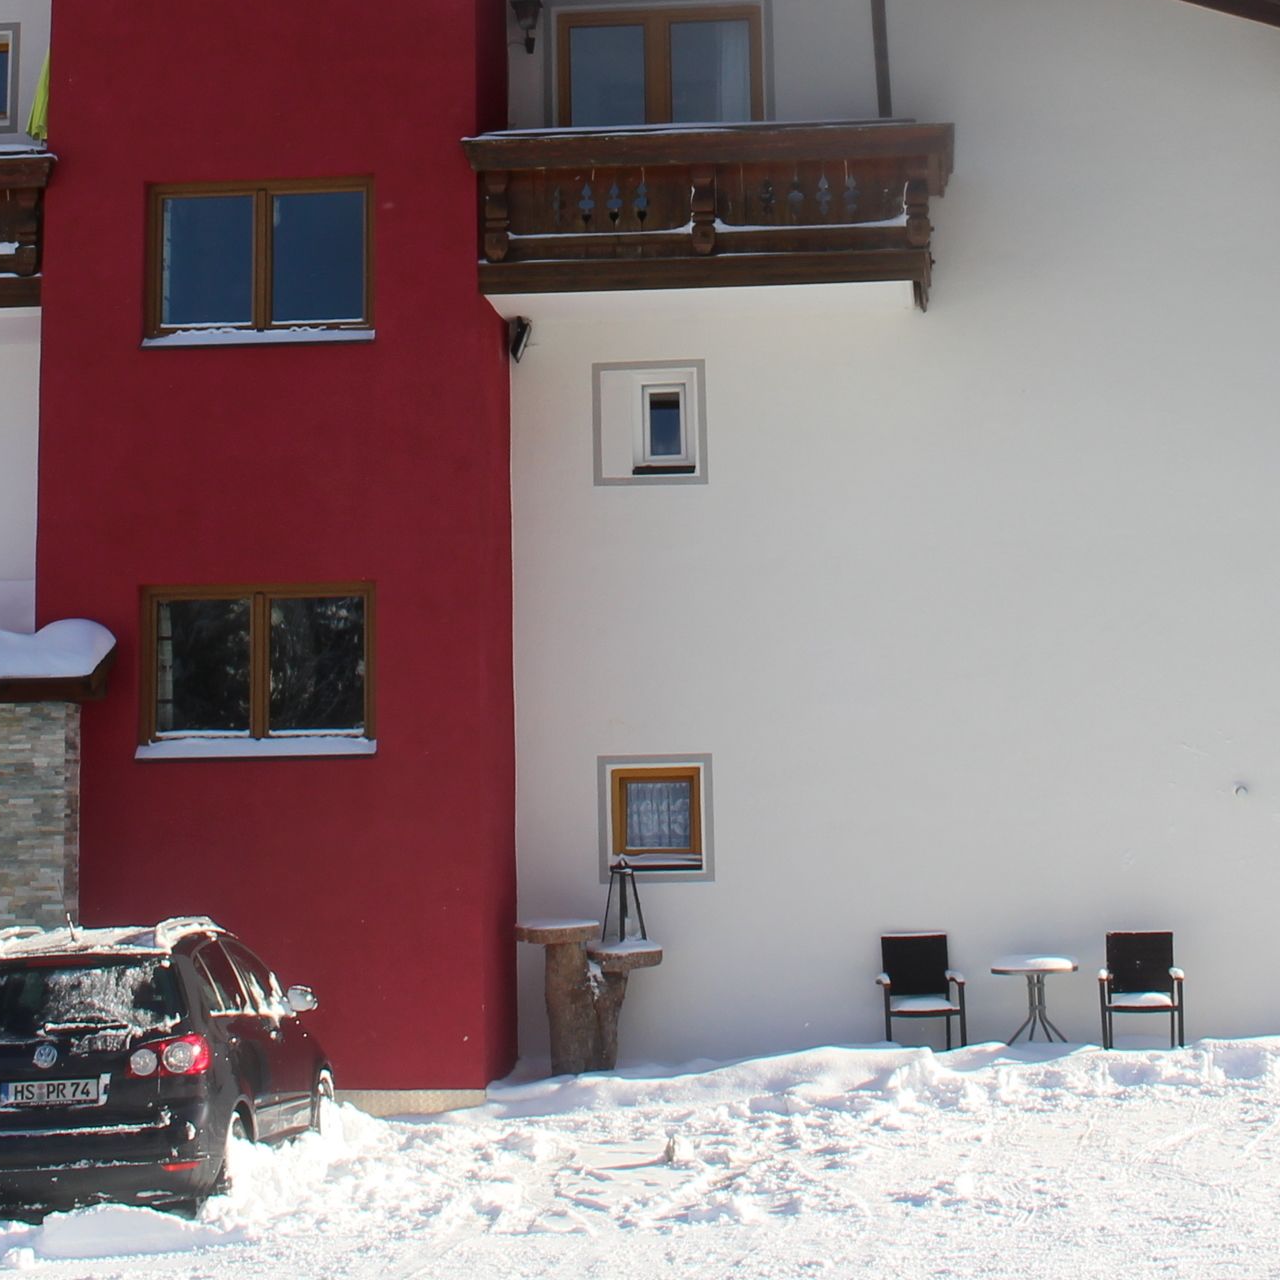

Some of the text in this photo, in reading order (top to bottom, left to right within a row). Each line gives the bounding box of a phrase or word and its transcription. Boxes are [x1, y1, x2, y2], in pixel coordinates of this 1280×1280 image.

[14, 1082, 91, 1100] HS PR 74
